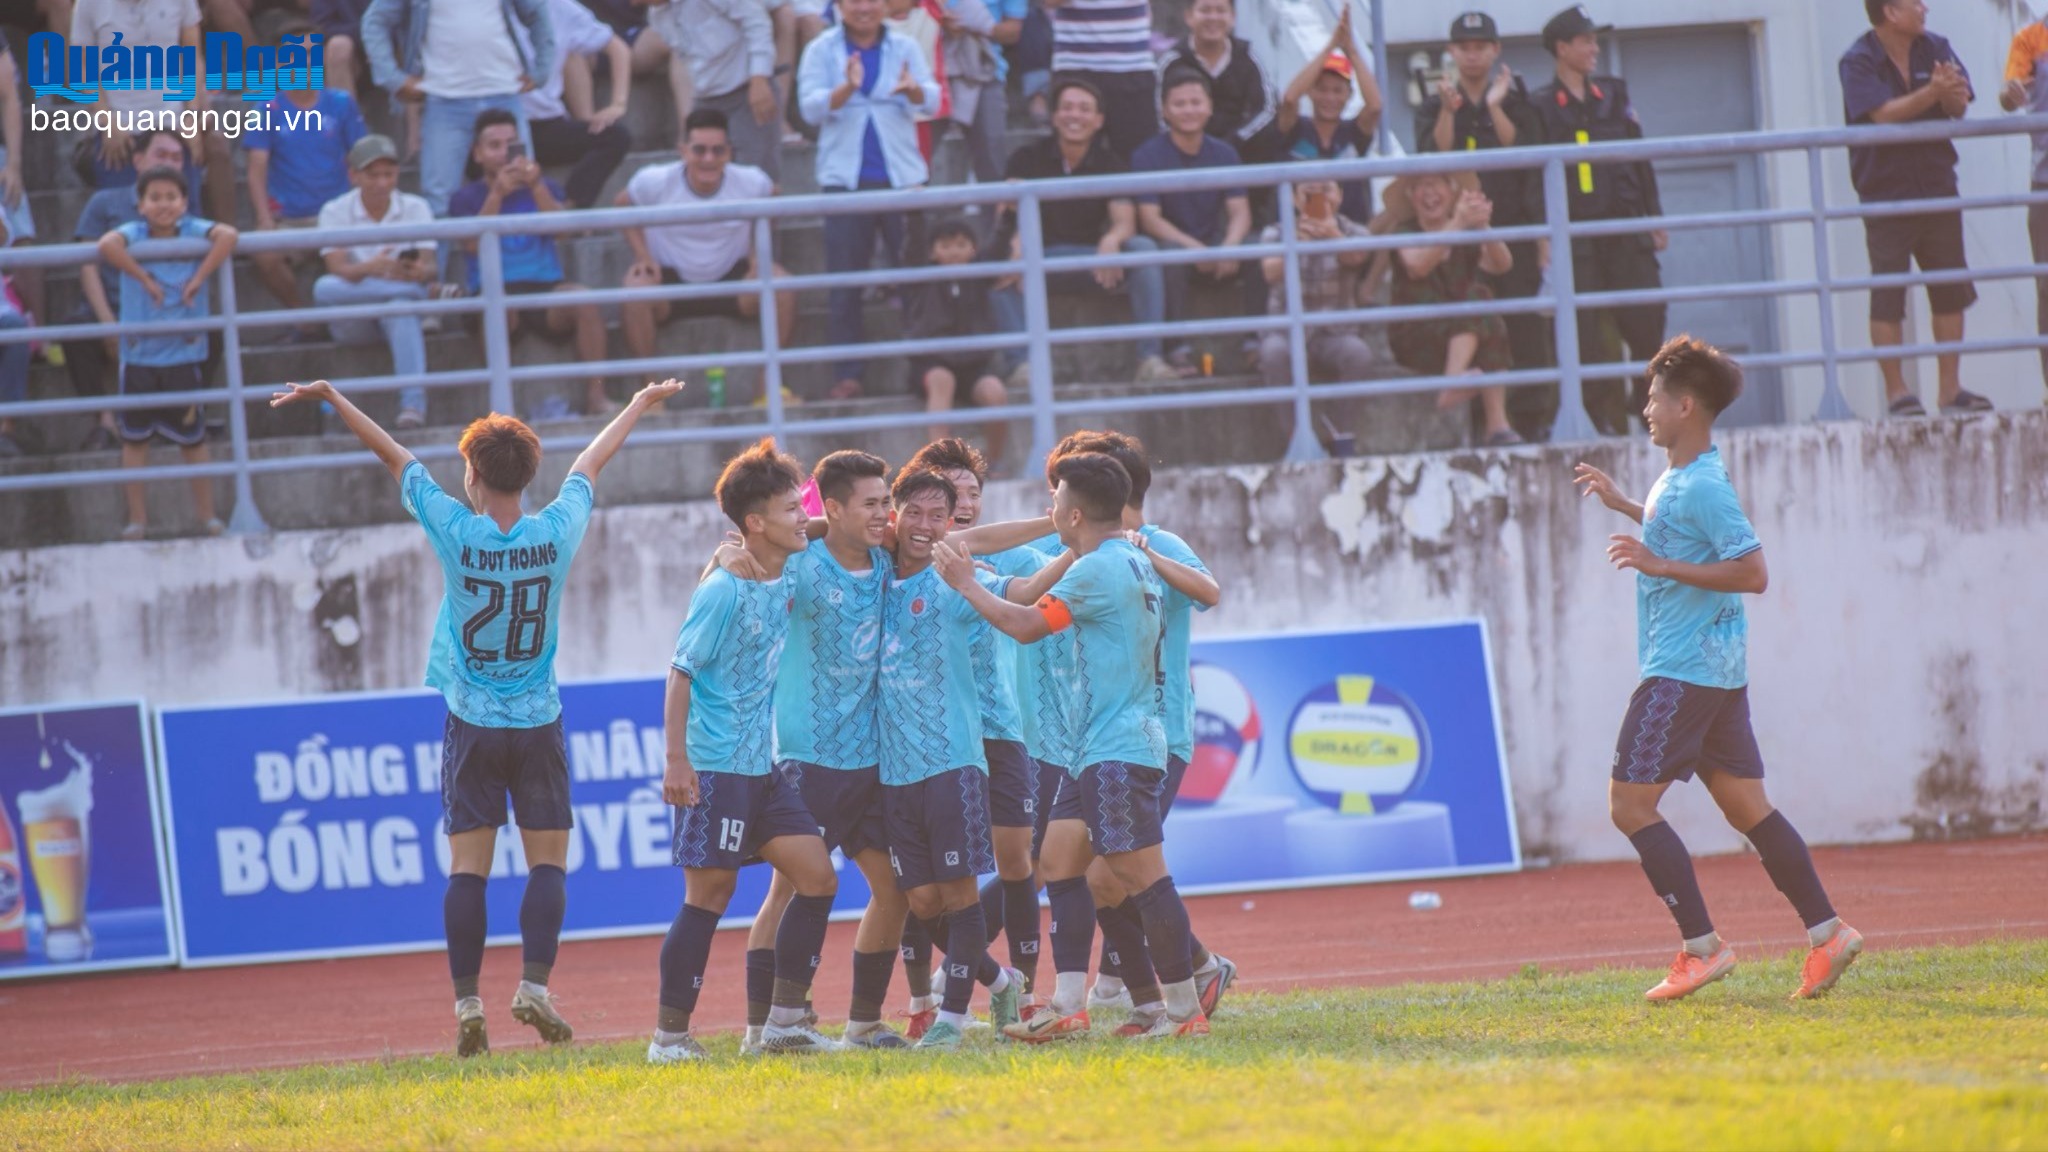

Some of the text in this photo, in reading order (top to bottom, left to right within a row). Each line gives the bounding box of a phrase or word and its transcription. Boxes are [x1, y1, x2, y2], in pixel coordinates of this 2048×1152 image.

[478, 549, 506, 572] DUY
[463, 575, 552, 662] 28
[254, 733, 409, 804] ĐỒNG
[570, 719, 667, 783] NÂN
[216, 809, 425, 897] BÓNG
[719, 817, 745, 852] 19
